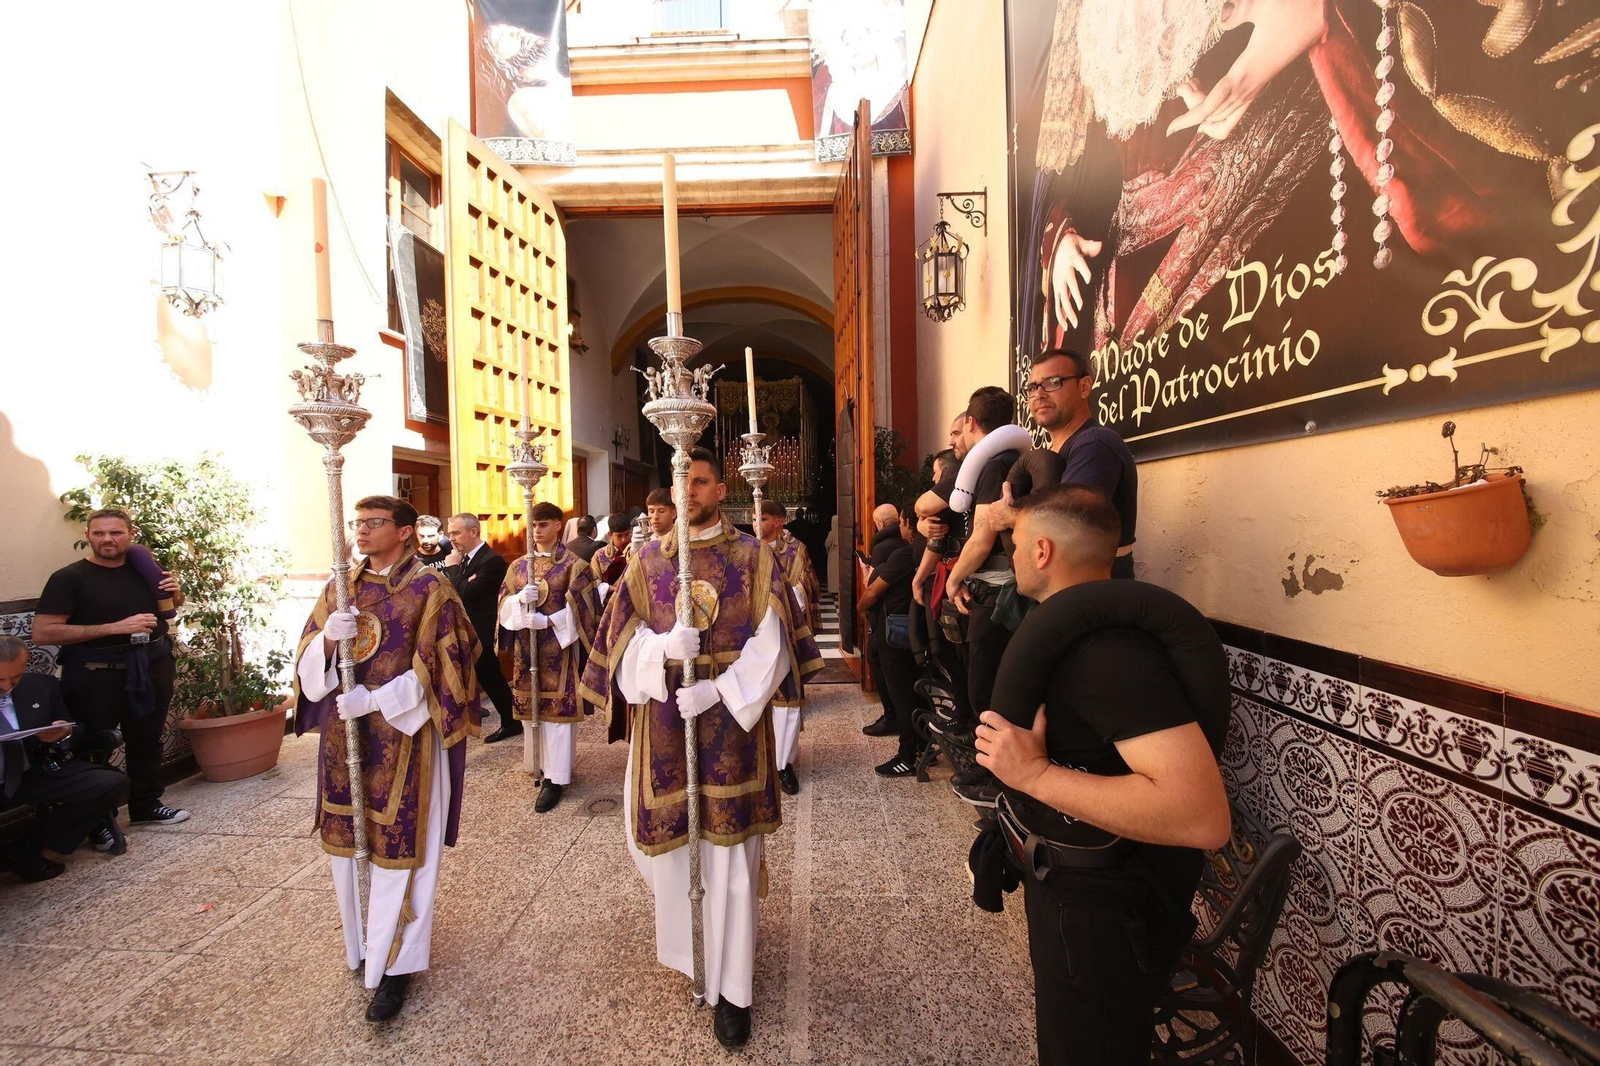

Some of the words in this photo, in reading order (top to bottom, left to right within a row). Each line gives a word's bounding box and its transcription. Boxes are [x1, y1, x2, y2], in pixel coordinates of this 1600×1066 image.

[1090, 329, 1170, 390] Madre
[1178, 312, 1210, 349] de
[1222, 249, 1337, 333] Dios
[1098, 384, 1129, 427] del
